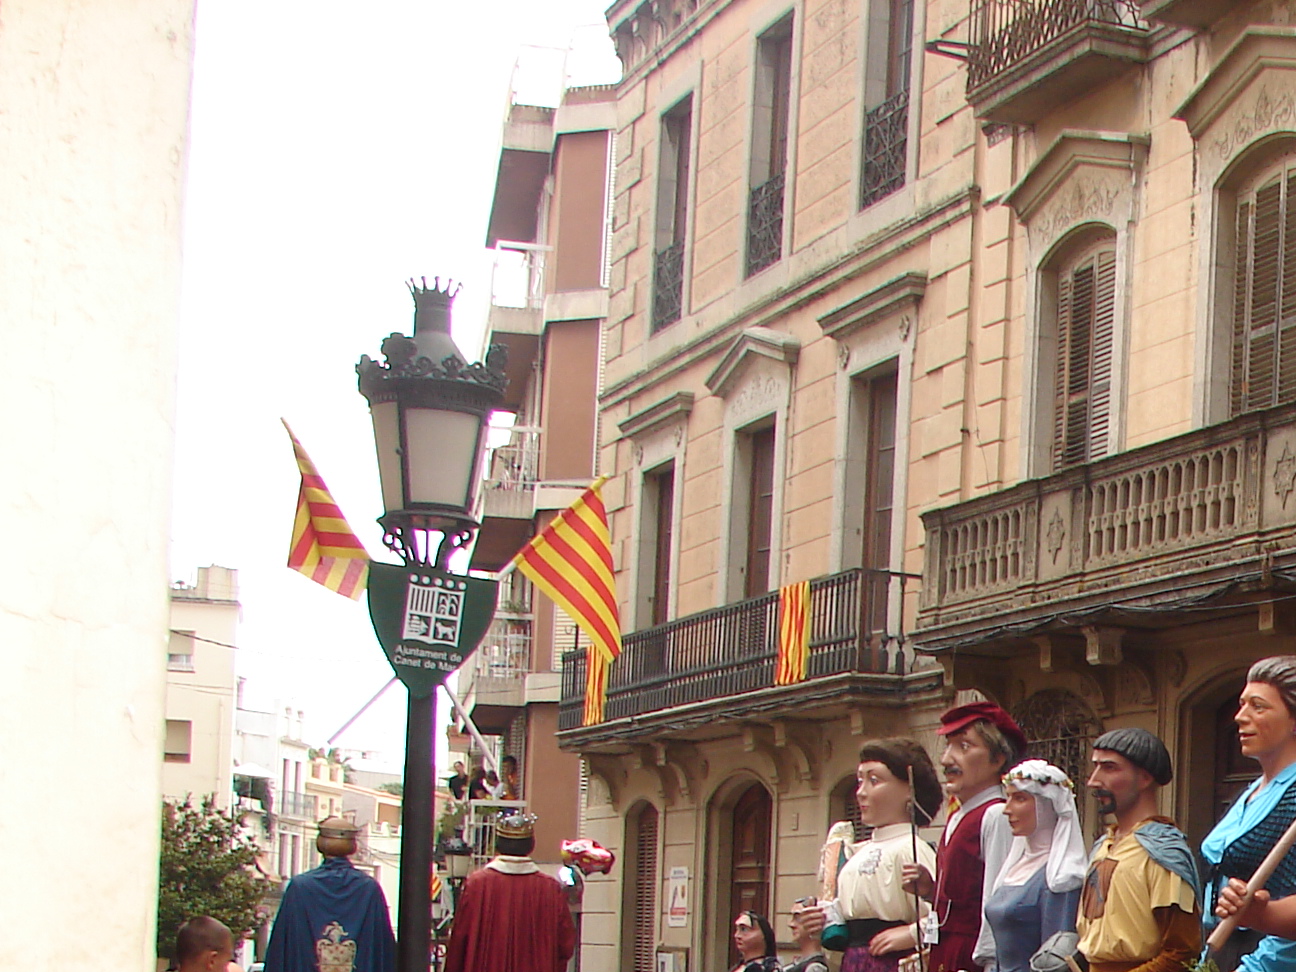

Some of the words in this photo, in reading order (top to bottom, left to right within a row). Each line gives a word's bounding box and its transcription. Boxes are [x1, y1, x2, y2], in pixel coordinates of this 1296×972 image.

[393, 654, 422, 668] Canet
[424, 660, 437, 670] de
[395, 644, 448, 661] Ajuntament
[449, 652, 463, 663] de
